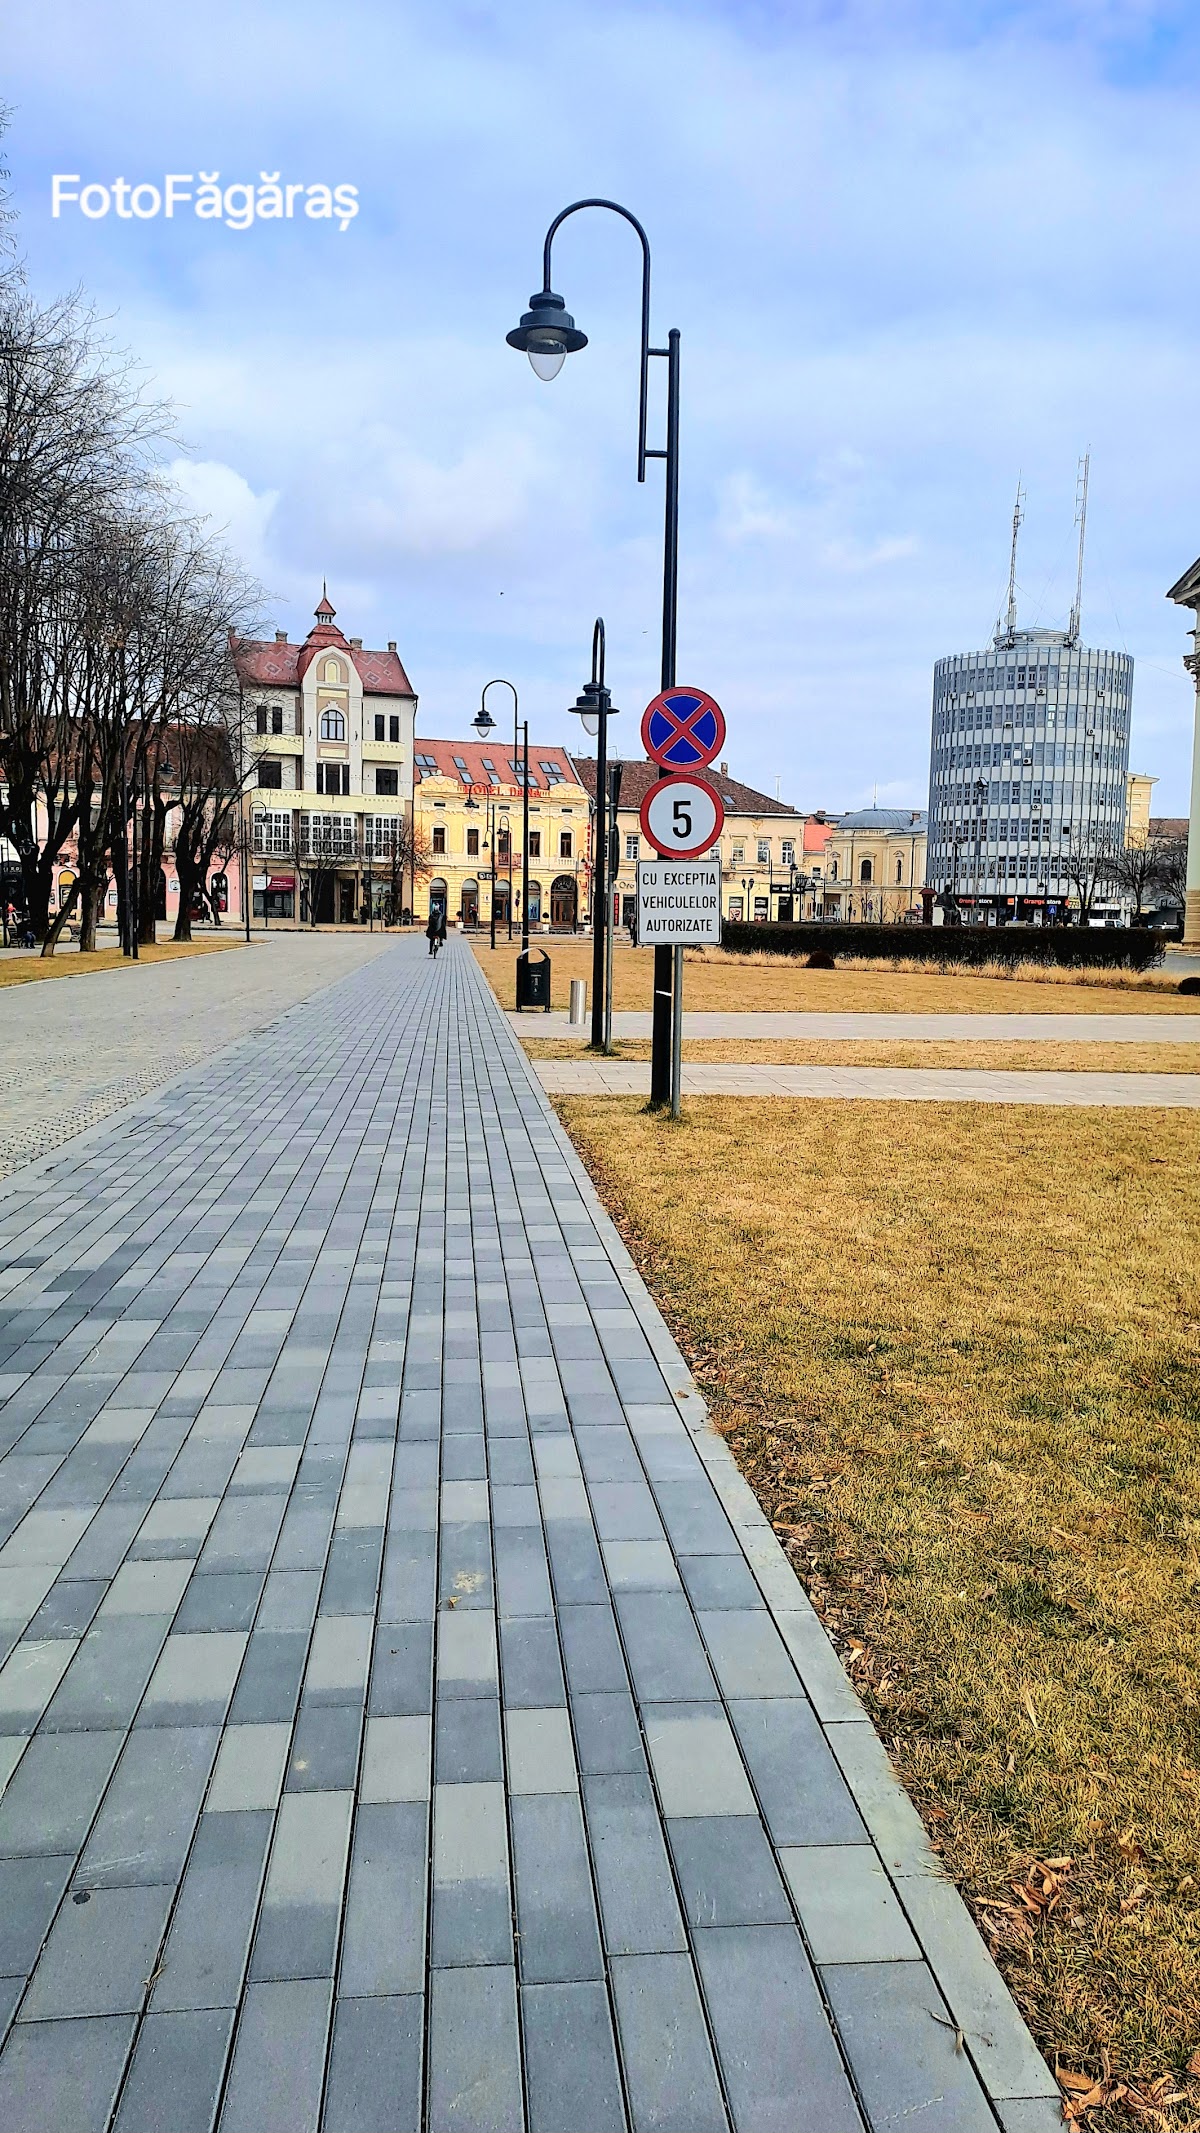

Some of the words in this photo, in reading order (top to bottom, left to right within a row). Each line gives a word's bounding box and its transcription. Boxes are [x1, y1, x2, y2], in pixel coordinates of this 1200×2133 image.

[672, 800, 692, 838] 5
[642, 872, 658, 886] CU
[664, 872, 717, 887] EXCEPȚIA
[642, 895, 717, 909] VEHICULELOR
[646, 919, 713, 932] AUTORIZATE
